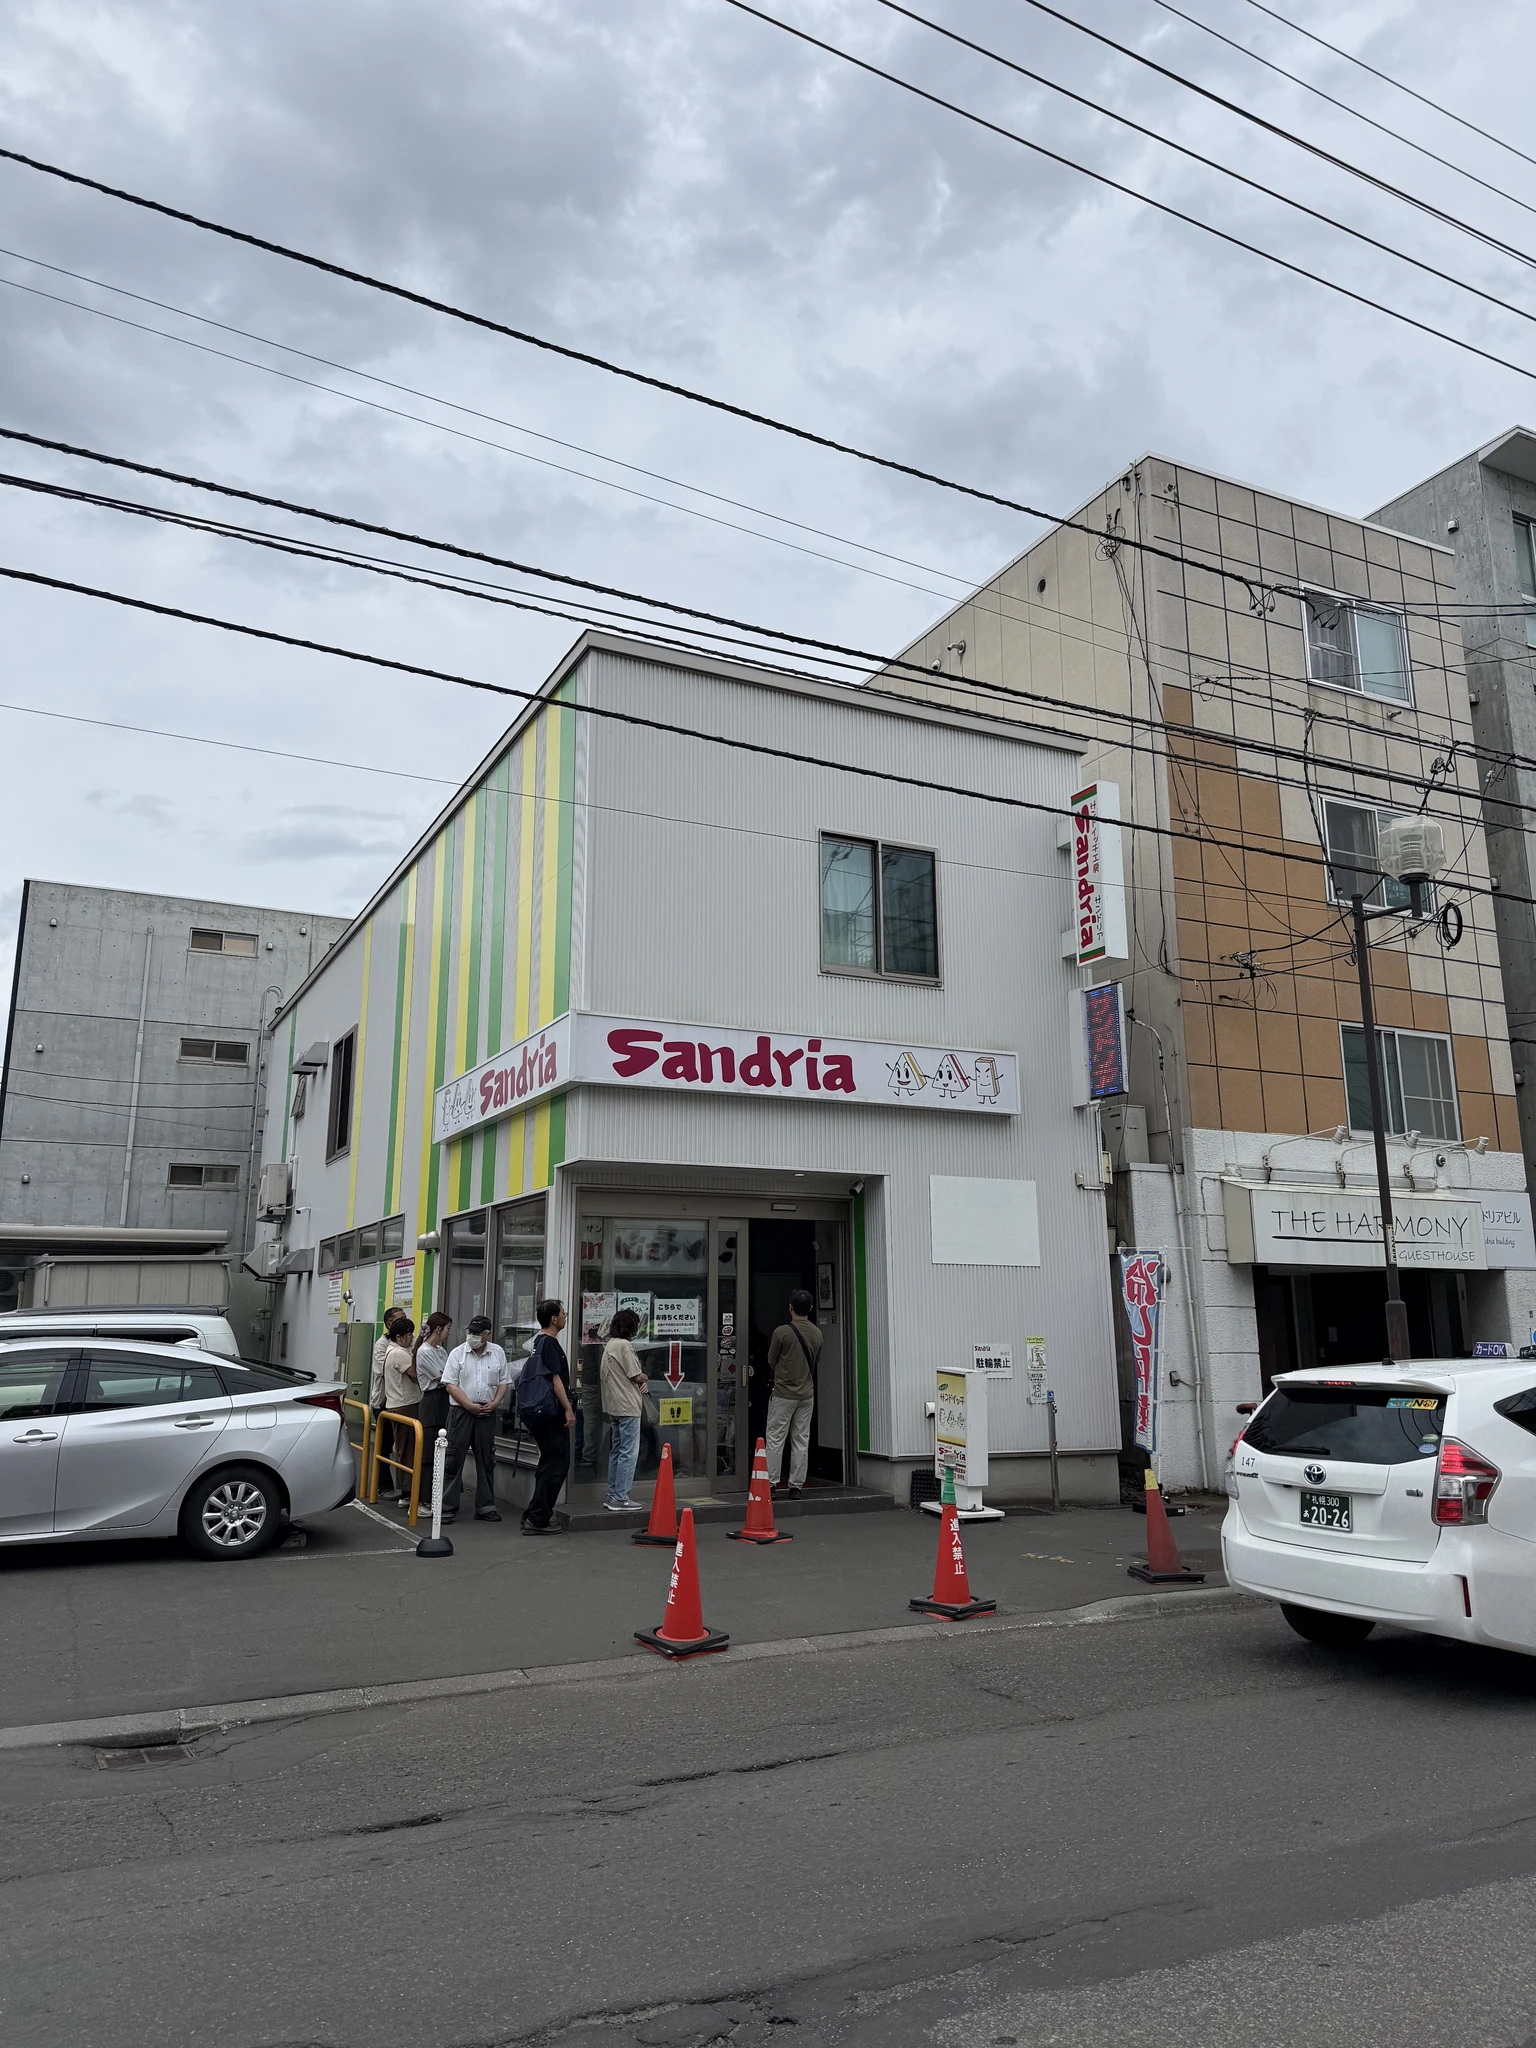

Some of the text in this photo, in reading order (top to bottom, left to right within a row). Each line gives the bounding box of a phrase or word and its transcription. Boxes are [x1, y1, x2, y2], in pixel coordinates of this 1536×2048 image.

[1074, 803, 1094, 948] Sandria
[607, 1028, 857, 1093] Sandria
[479, 1033, 558, 1116] Sandria
[1271, 1210, 1326, 1235] THE
[1335, 1211, 1469, 1248] HARMONY
[1496, 1236, 1516, 1248] building
[1398, 1249, 1476, 1263] GUESTHOUSE
[658, 1303, 682, 1311] こちらで
[1475, 1344, 1505, 1356] カードOK
[976, 1357, 1011, 1369] 駐輪禁止
[1241, 1456, 1256, 1468] 147
[1302, 1505, 1349, 1528] あ 20-26
[950, 1518, 965, 1575] 進入禁止
